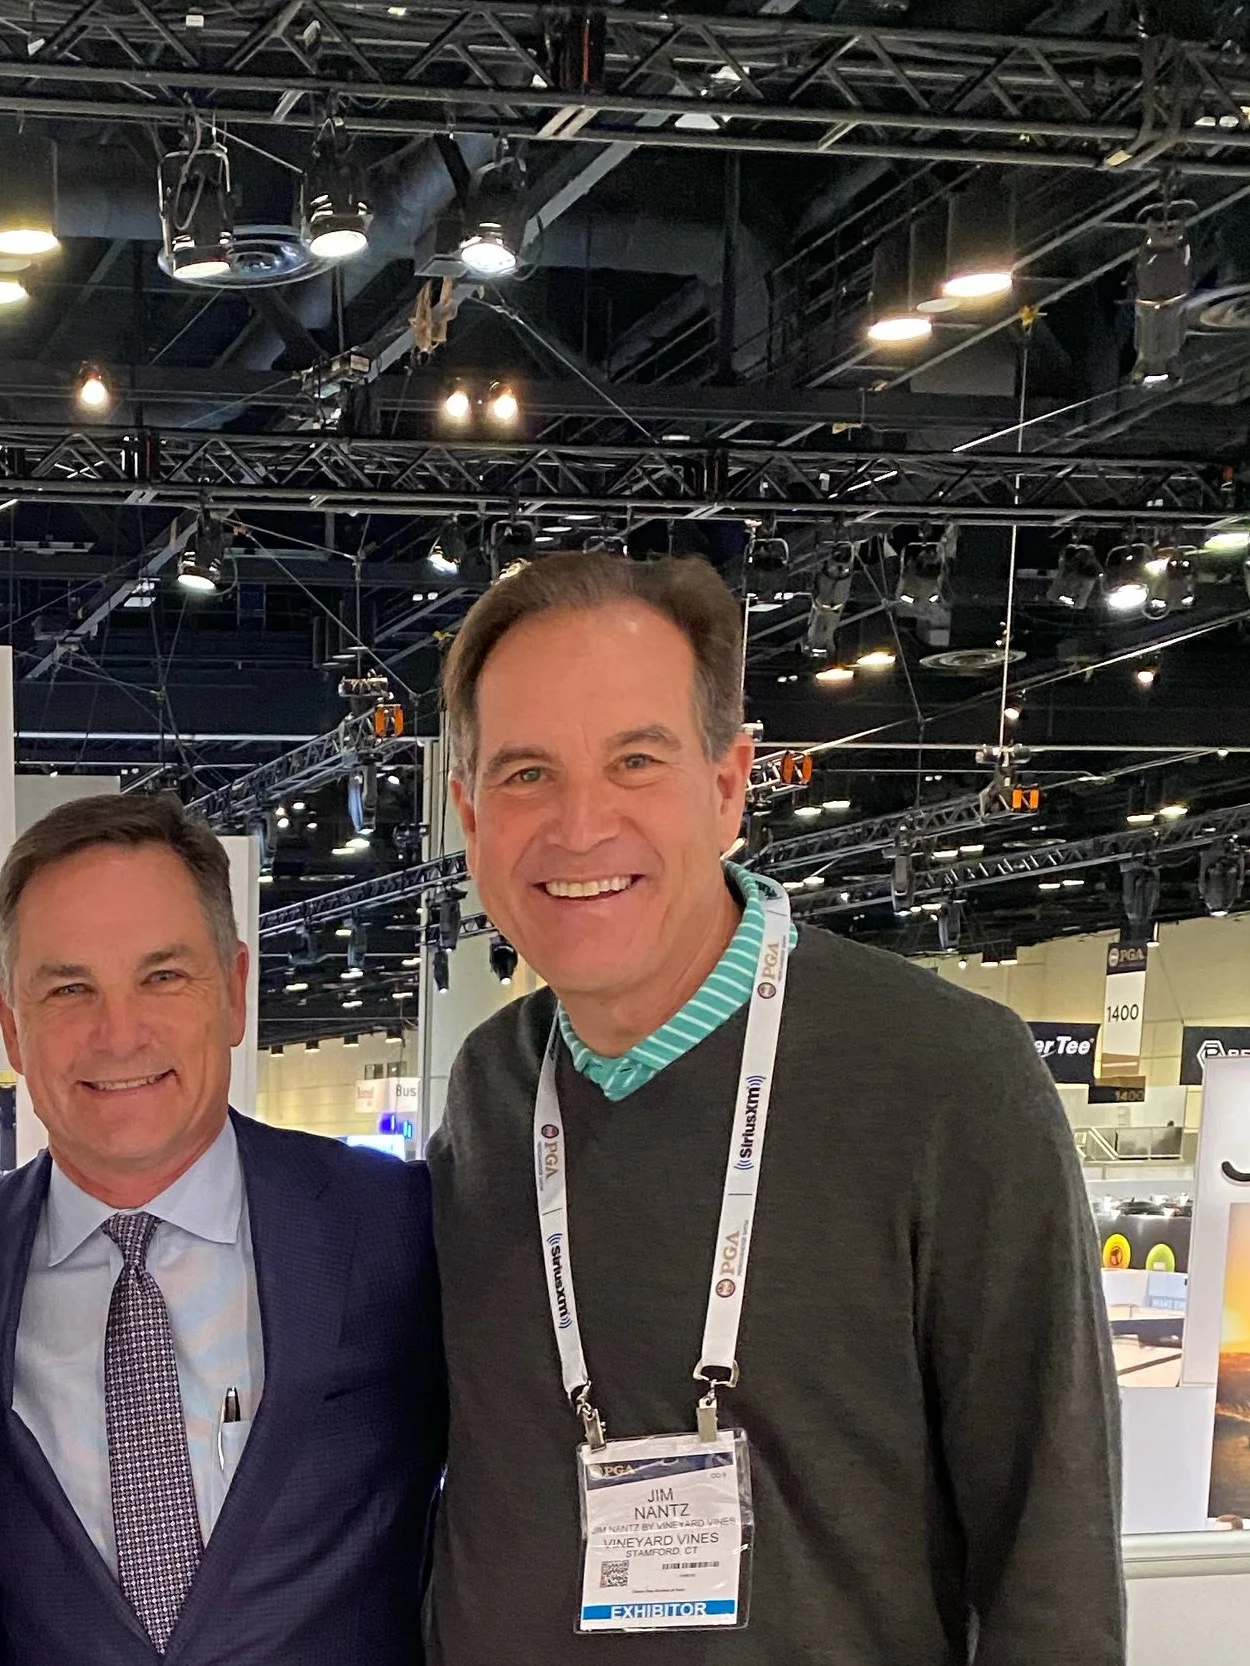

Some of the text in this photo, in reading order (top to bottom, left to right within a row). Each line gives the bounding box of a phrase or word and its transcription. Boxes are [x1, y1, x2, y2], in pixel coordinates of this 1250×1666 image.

[761, 941, 780, 981] PGA
[1107, 1003, 1140, 1022] 1400
[1056, 1035, 1091, 1056] Tee
[544, 1141, 559, 1179] PGA
[720, 1230, 740, 1276] PGA
[647, 1487, 674, 1503] JIM
[634, 1503, 691, 1520] NANTZ
[608, 1523, 640, 1533] NANTZ
[642, 1522, 655, 1531] BY
[656, 1519, 705, 1530] VINEYARD
[707, 1516, 736, 1527] VINES
[603, 1532, 719, 1549] VINEYARD VINES
[684, 1546, 699, 1555] CT
[611, 1602, 707, 1619] EXHIBITOR
